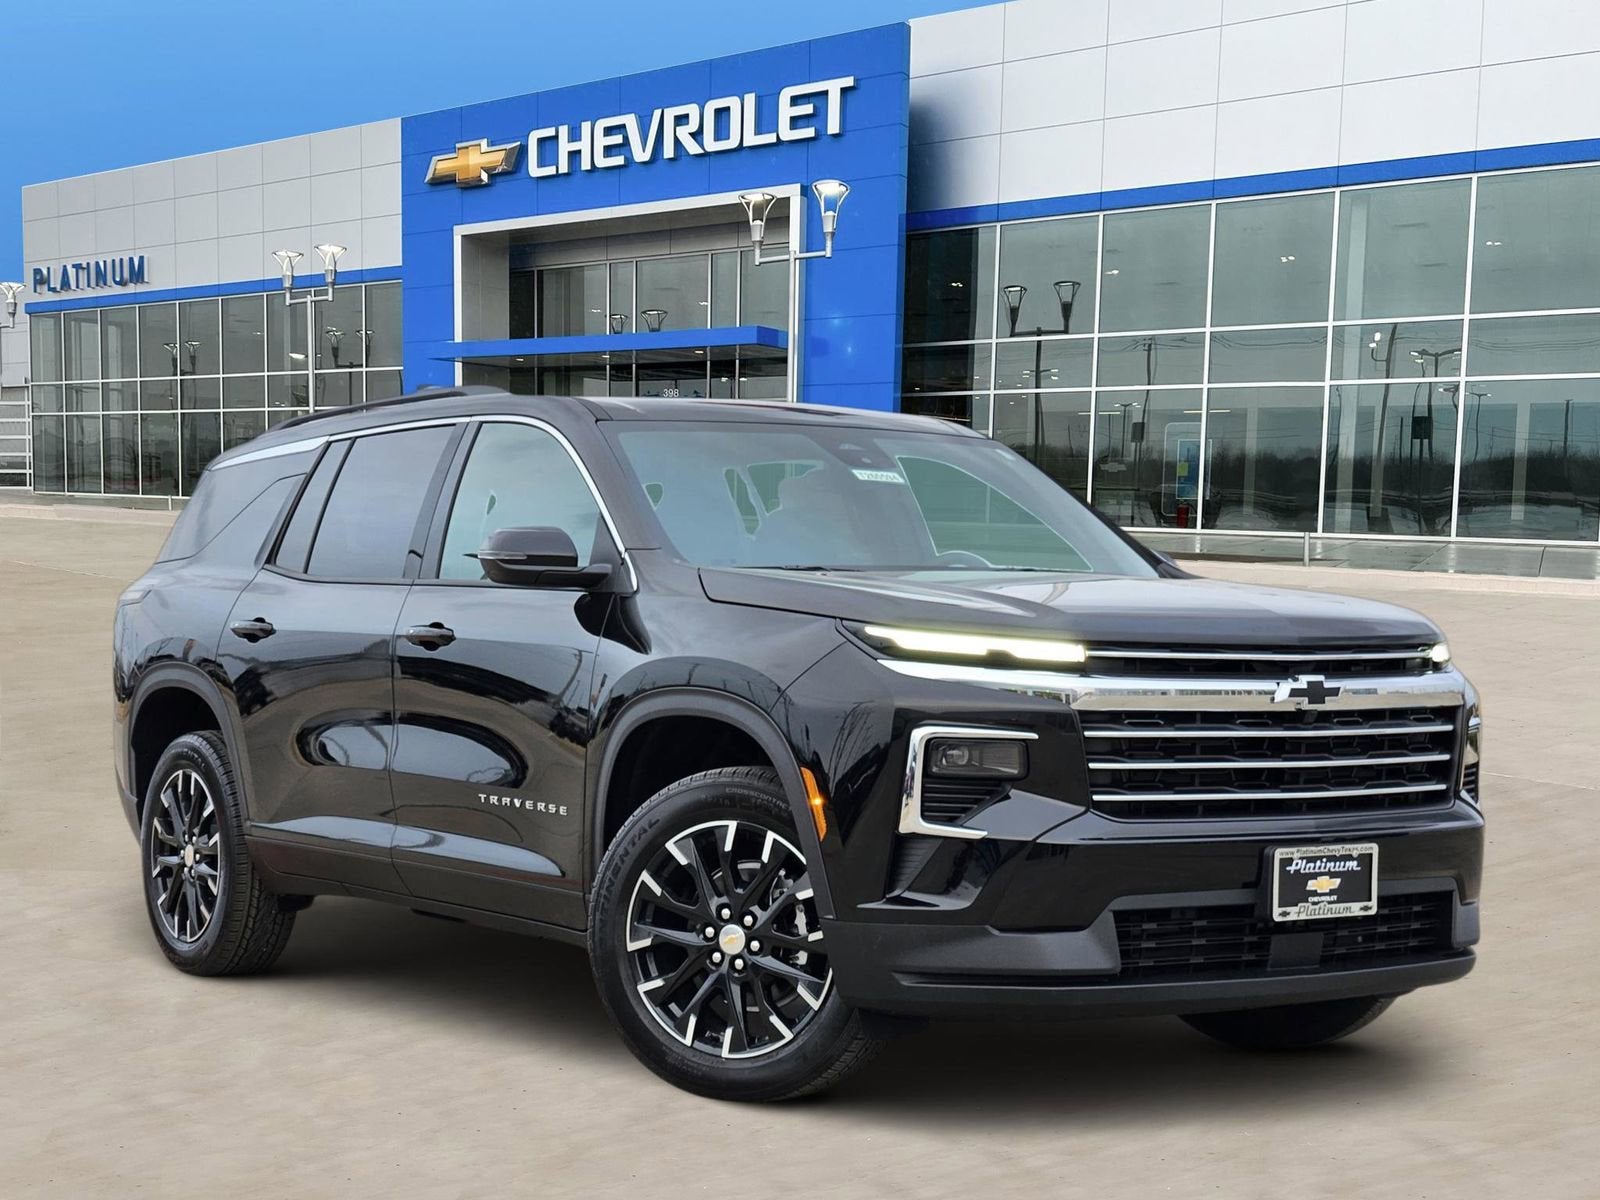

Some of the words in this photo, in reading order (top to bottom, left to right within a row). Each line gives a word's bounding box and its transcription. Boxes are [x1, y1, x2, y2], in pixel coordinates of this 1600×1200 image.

[527, 75, 856, 178] CHEVROLET
[33, 255, 149, 294] PLATINUM
[663, 388, 680, 398] 398
[478, 793, 568, 816] TRAVERSE
[1286, 858, 1361, 873] Platinum
[1295, 903, 1355, 917] Platinum
